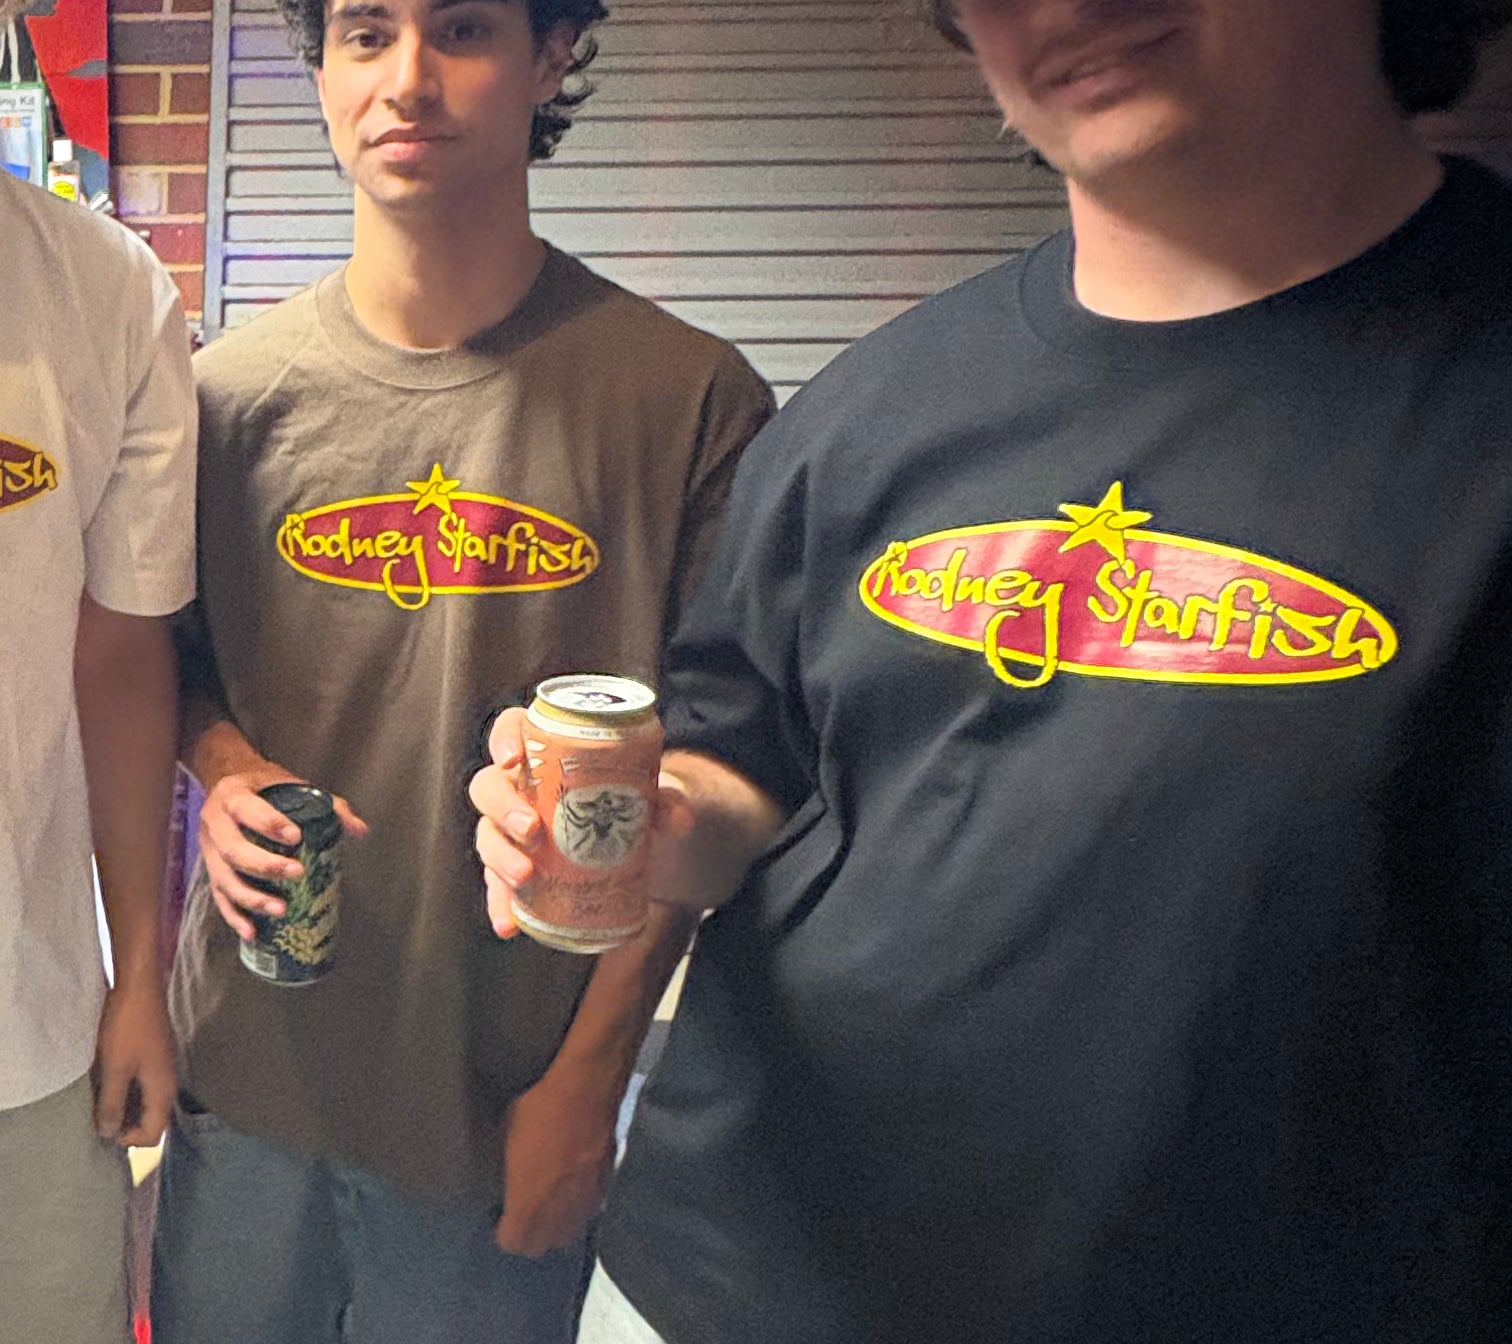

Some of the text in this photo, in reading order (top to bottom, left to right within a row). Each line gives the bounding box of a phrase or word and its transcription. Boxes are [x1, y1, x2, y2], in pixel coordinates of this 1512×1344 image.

[20, 95, 35, 105] Kit
[284, 512, 595, 611] Rodney Starfish
[871, 541, 1390, 688] Rodney Starfish
